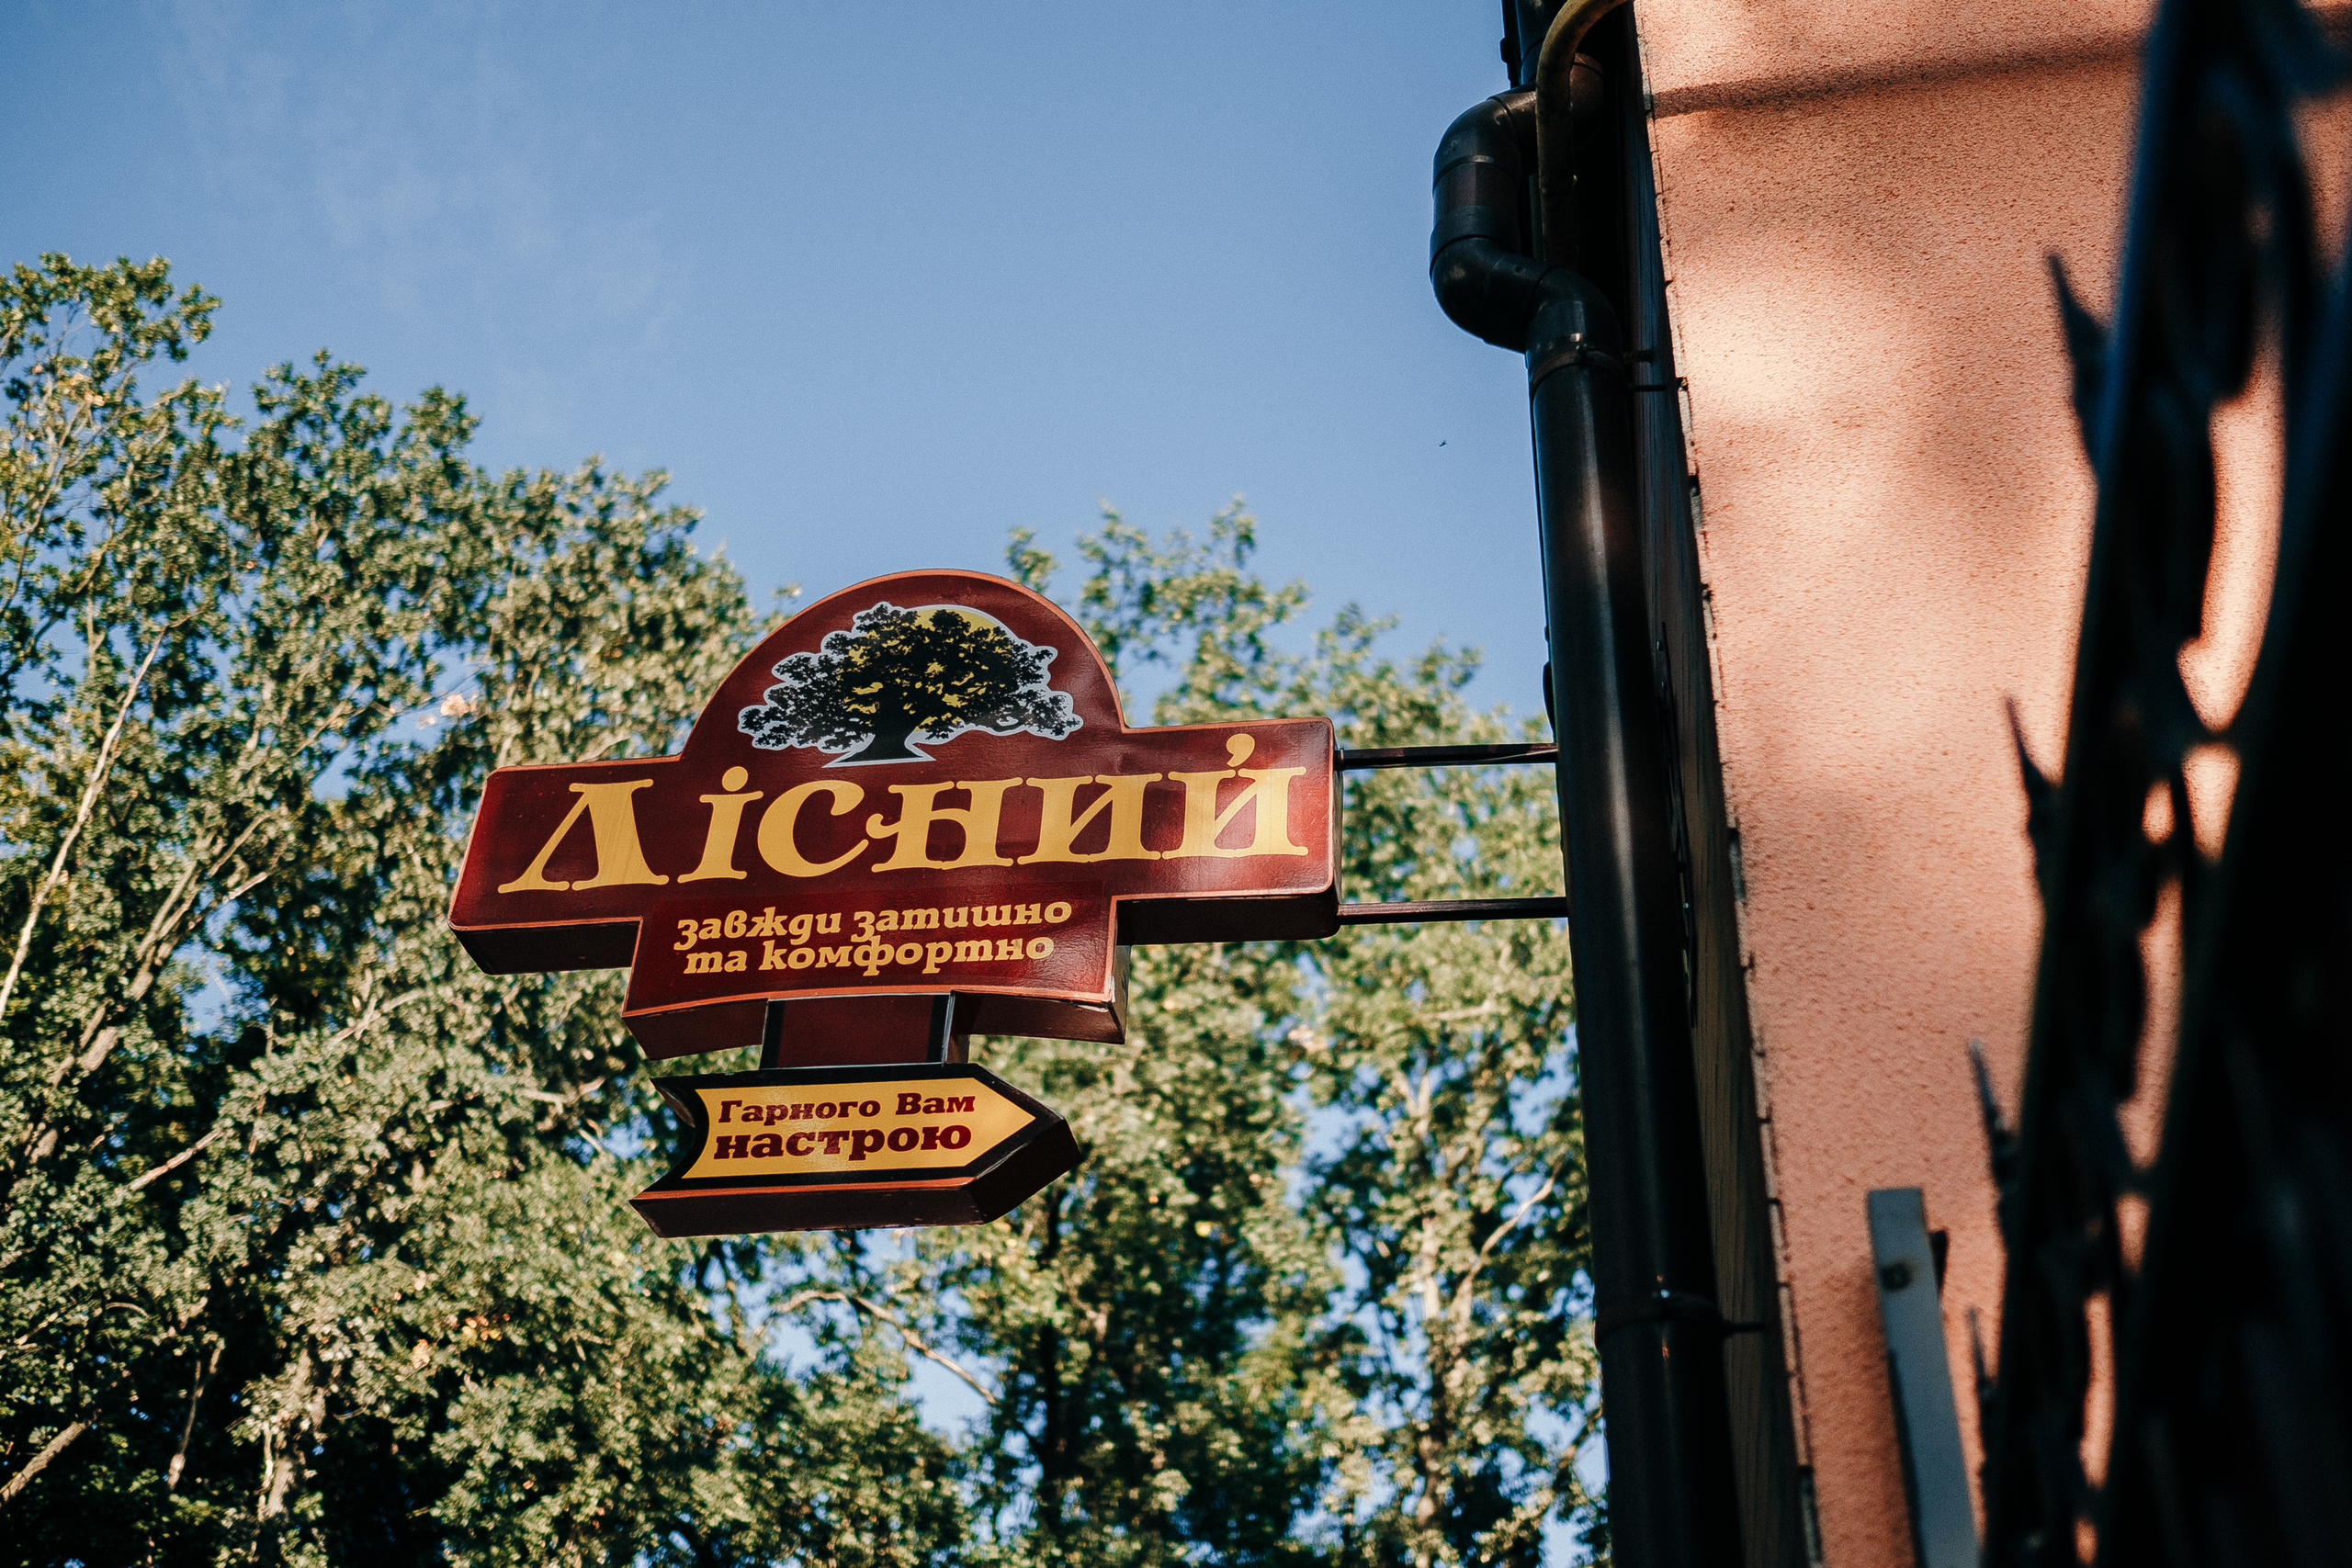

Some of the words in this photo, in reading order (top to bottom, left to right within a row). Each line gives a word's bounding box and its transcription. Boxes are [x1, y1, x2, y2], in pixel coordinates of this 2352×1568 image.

[498, 734, 1309, 893] Лісний
[673, 907, 842, 951] завжди
[850, 901, 1072, 942] затишно
[683, 948, 747, 974] та
[758, 935, 1055, 976] комфортно
[718, 1099, 881, 1126] Гарного
[895, 1091, 976, 1116] Вам
[713, 1123, 973, 1161] настрою
